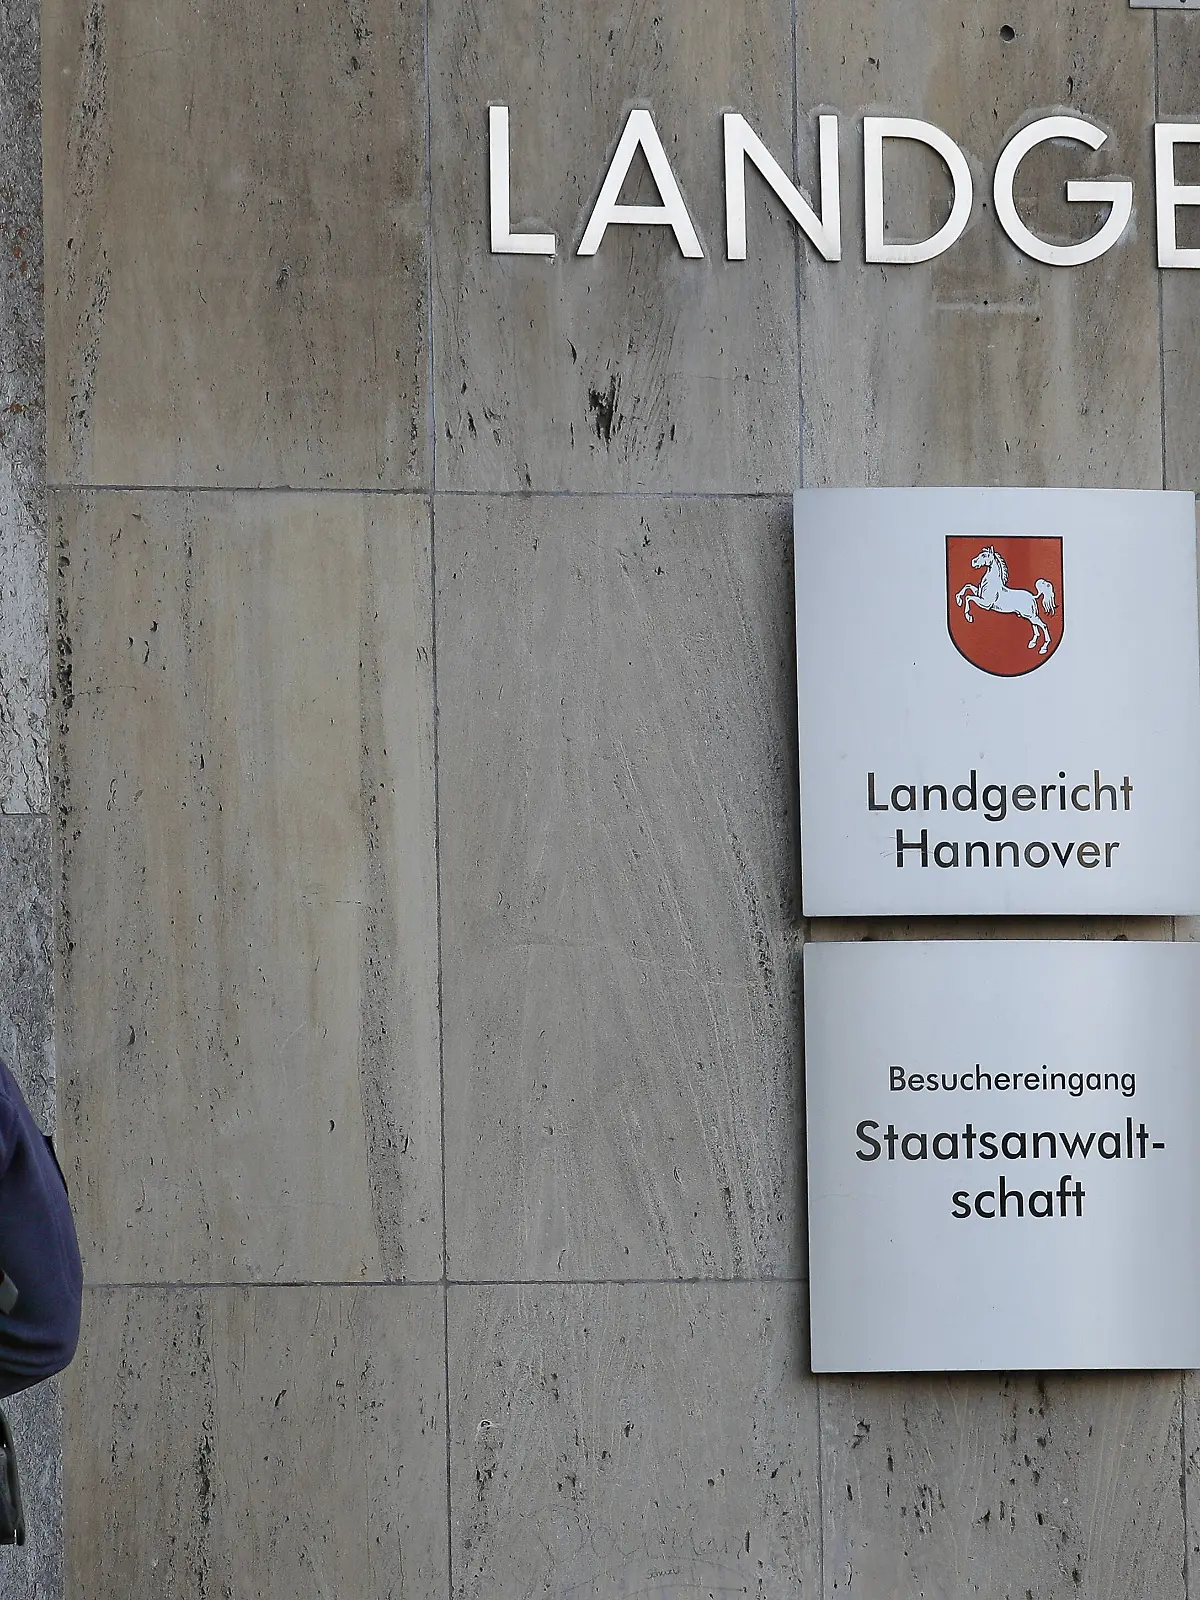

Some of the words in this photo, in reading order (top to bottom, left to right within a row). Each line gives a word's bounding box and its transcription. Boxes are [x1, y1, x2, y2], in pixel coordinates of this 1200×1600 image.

[867, 769, 1134, 822] Landgericht
[895, 828, 1120, 869] Hannover
[889, 1063, 1136, 1097] Besuchereingang
[855, 1116, 1165, 1162] Staatsanwalt-
[951, 1174, 1086, 1219] schaft
